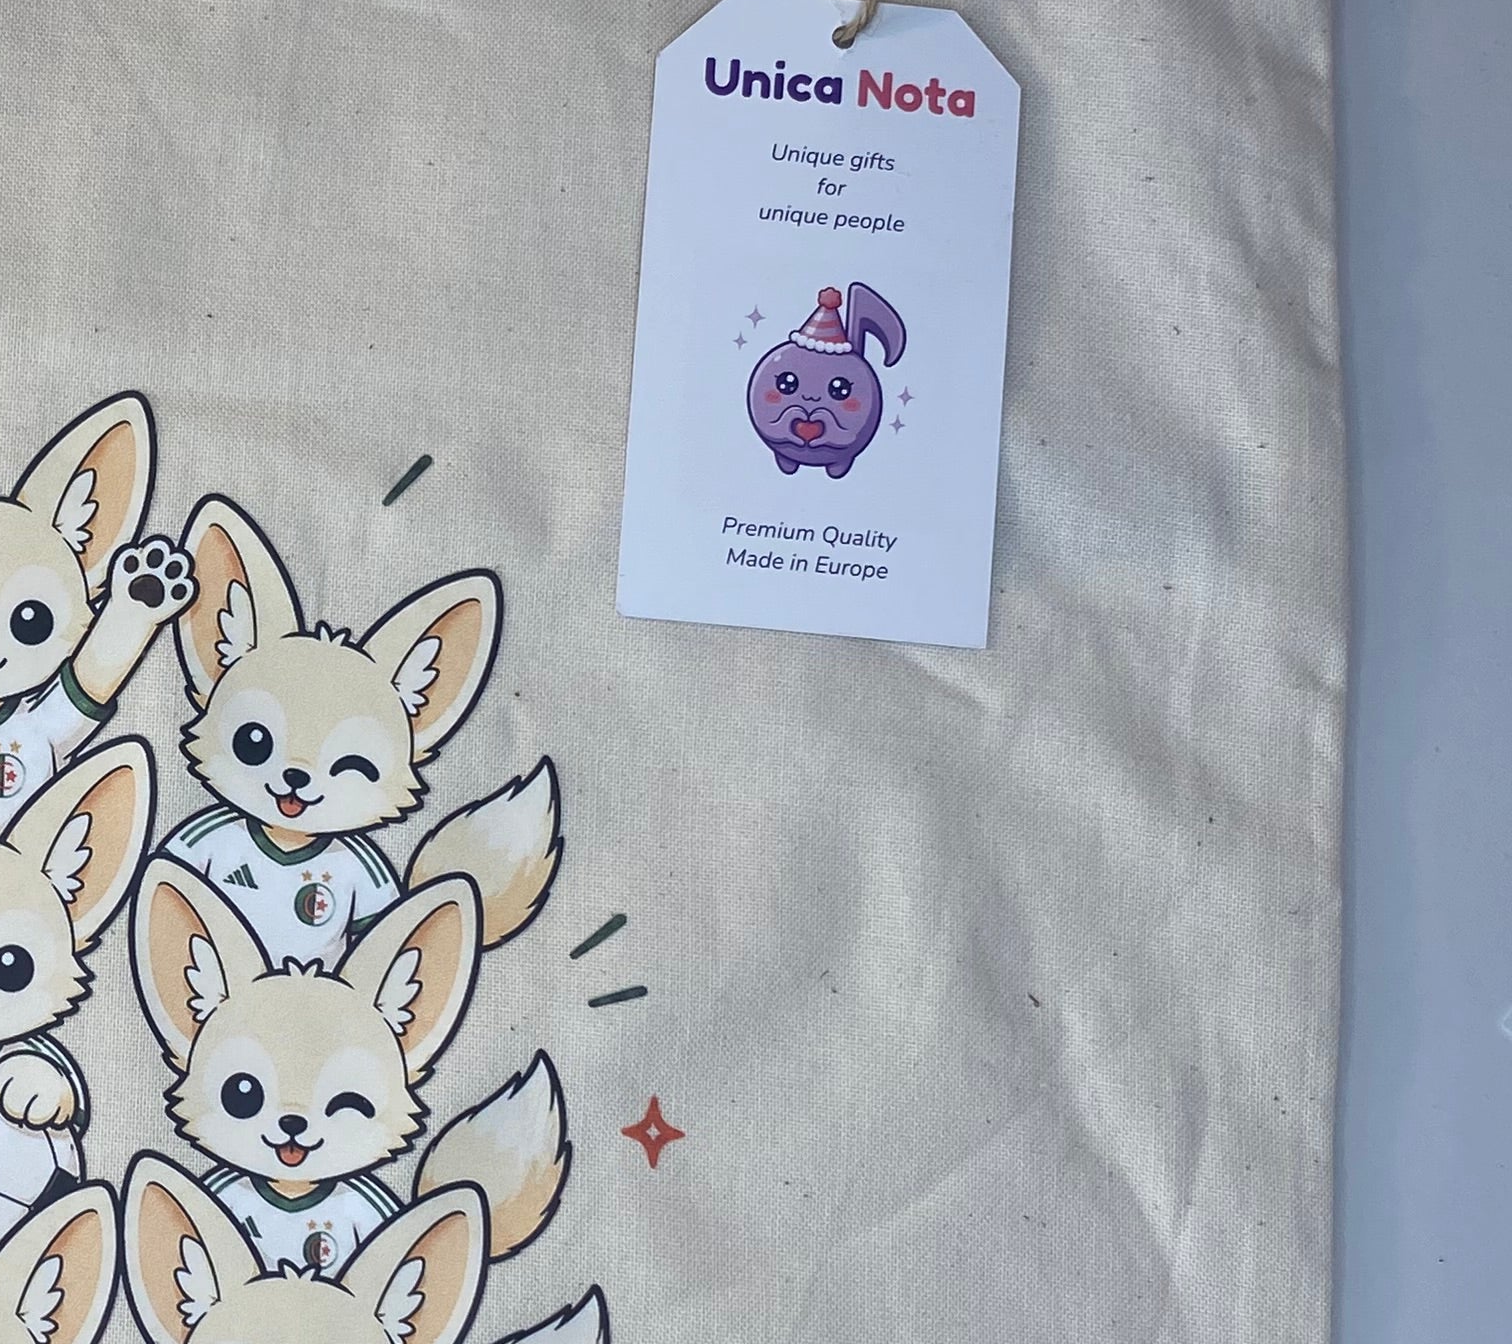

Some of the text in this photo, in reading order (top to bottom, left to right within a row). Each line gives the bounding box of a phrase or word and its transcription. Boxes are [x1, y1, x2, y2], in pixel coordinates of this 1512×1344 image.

[705, 57, 975, 118] Unica Nota
[772, 143, 895, 171] Unique gifts
[817, 177, 847, 197] for
[759, 206, 905, 233] unique people
[722, 516, 898, 552] Premium Quality
[726, 547, 889, 582] Made in Europe
